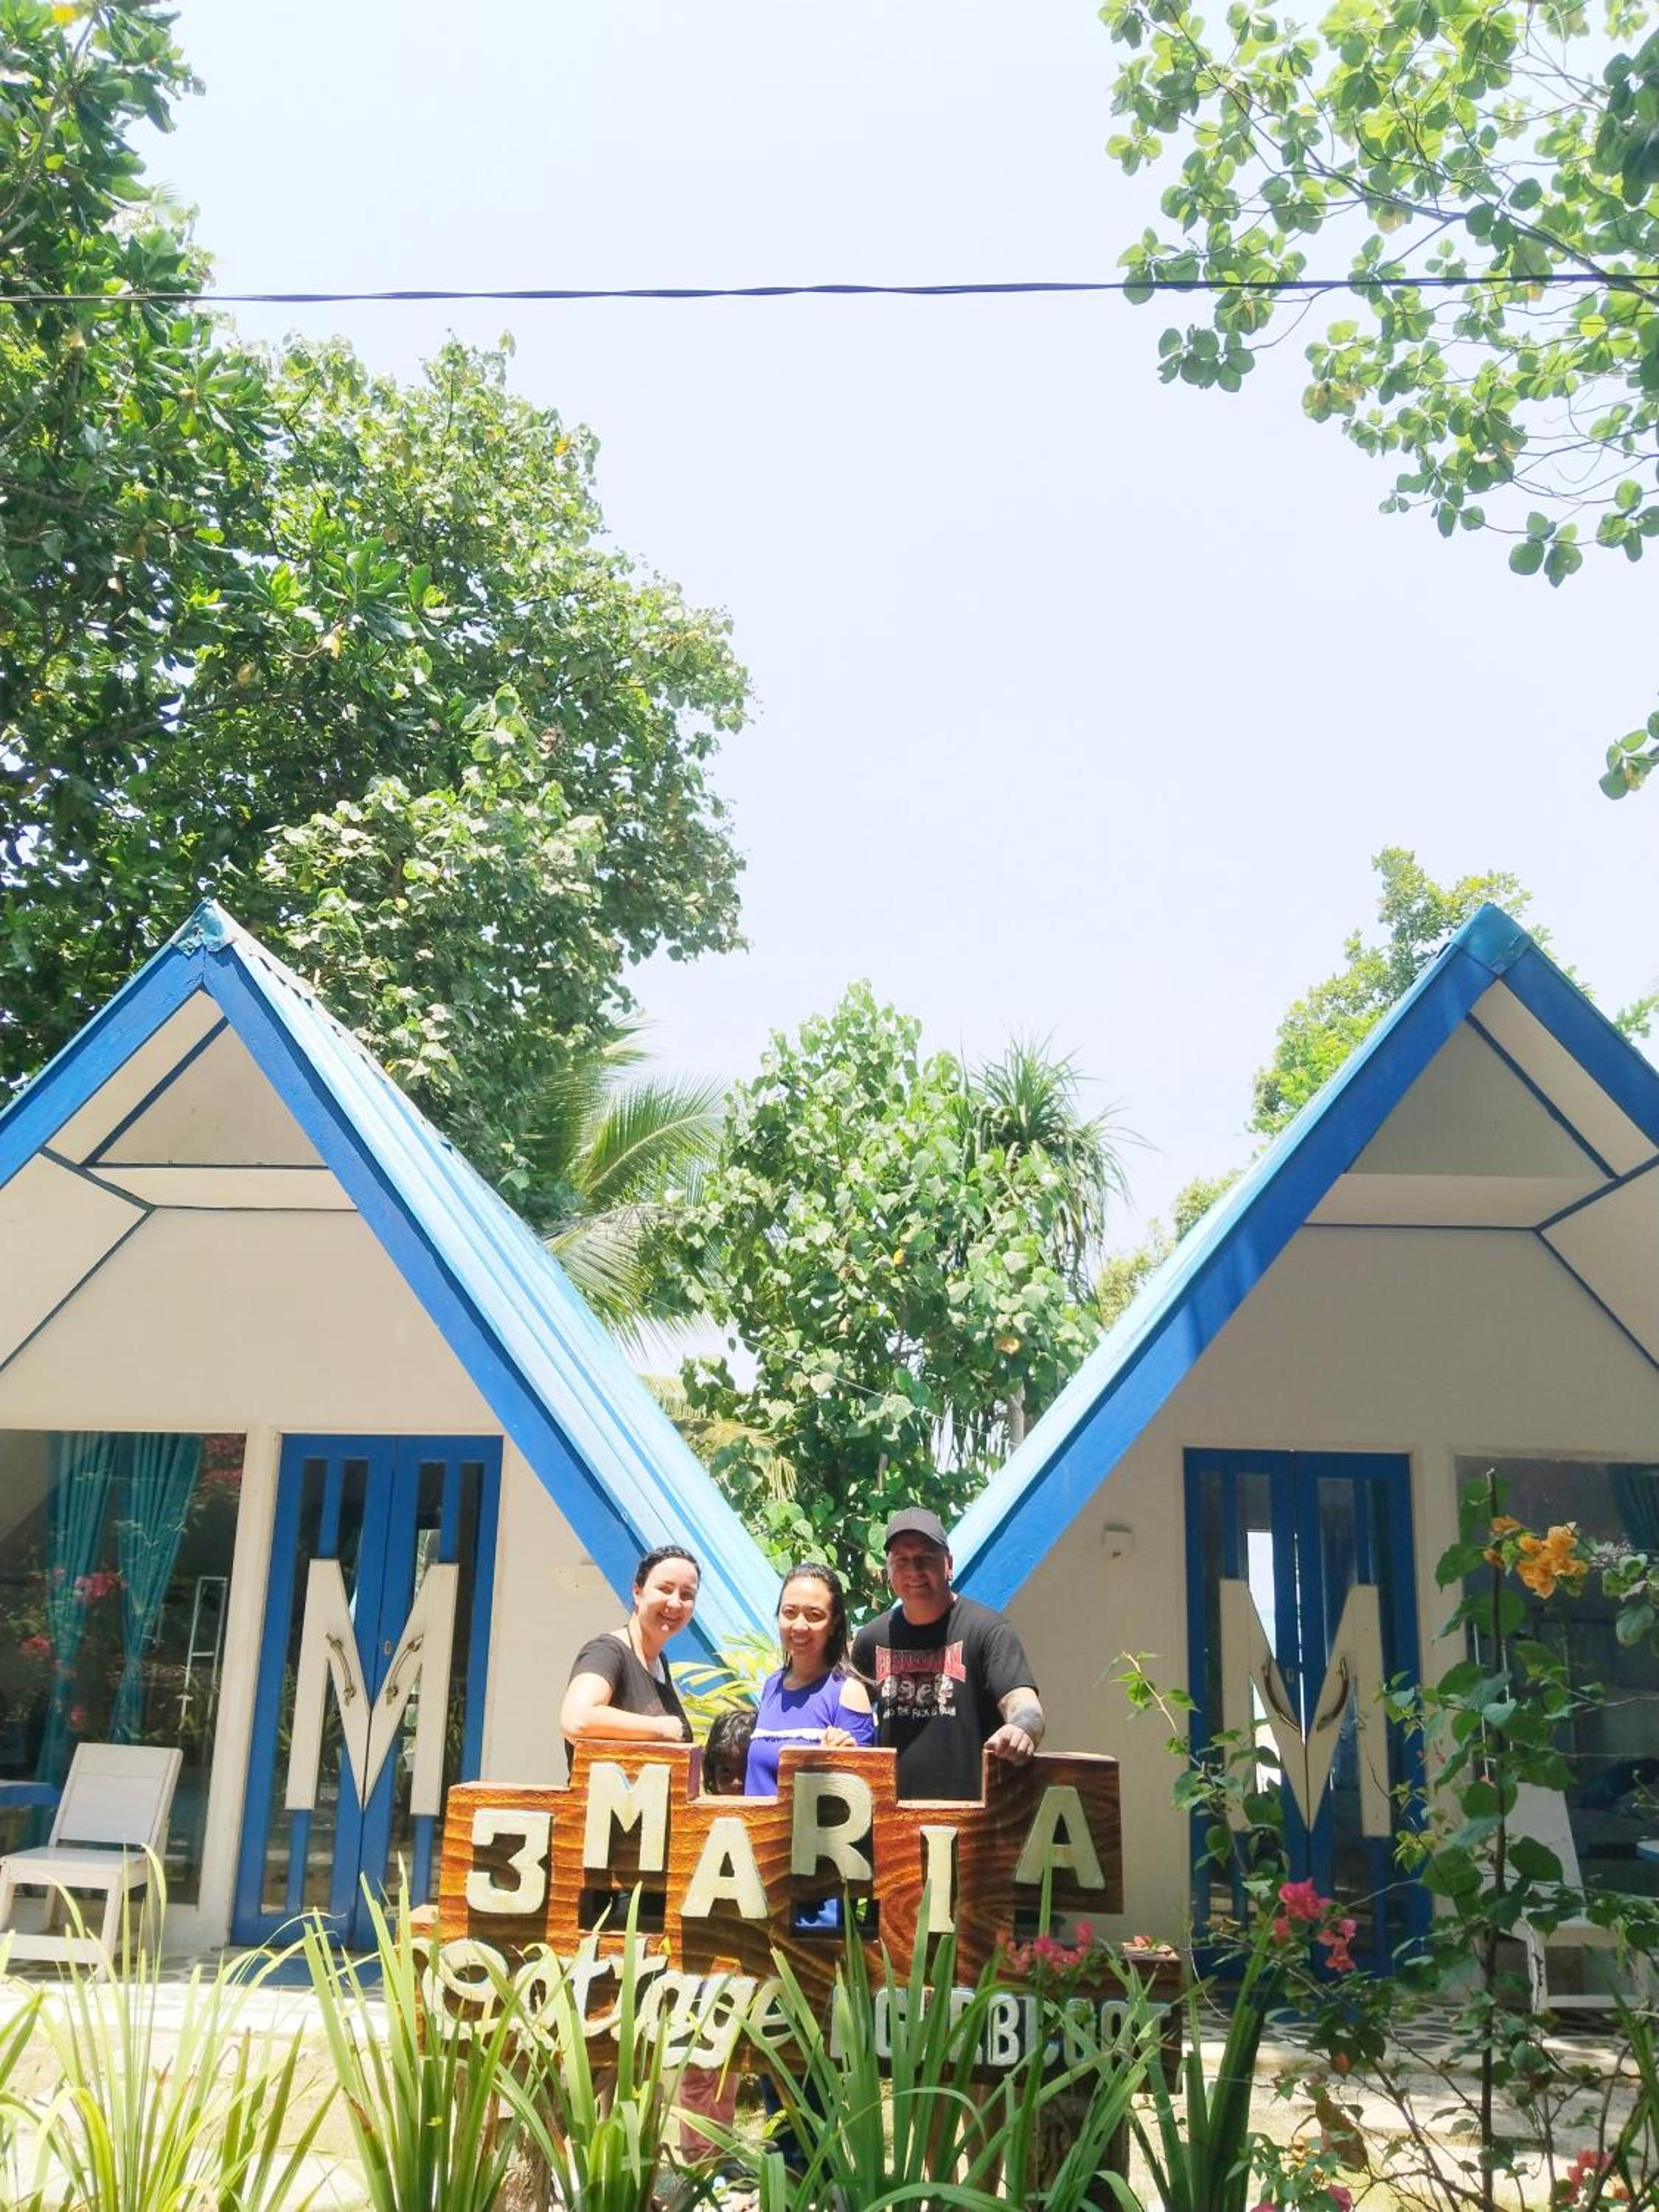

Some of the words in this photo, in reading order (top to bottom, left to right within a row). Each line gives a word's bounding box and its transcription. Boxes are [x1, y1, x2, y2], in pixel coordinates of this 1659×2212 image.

[285, 1558, 459, 1815] M
[1220, 1578, 1391, 1837] M
[465, 1808, 554, 1913] 3
[582, 1761, 1105, 1933] MARIA
[406, 1935, 797, 2069] Cottage
